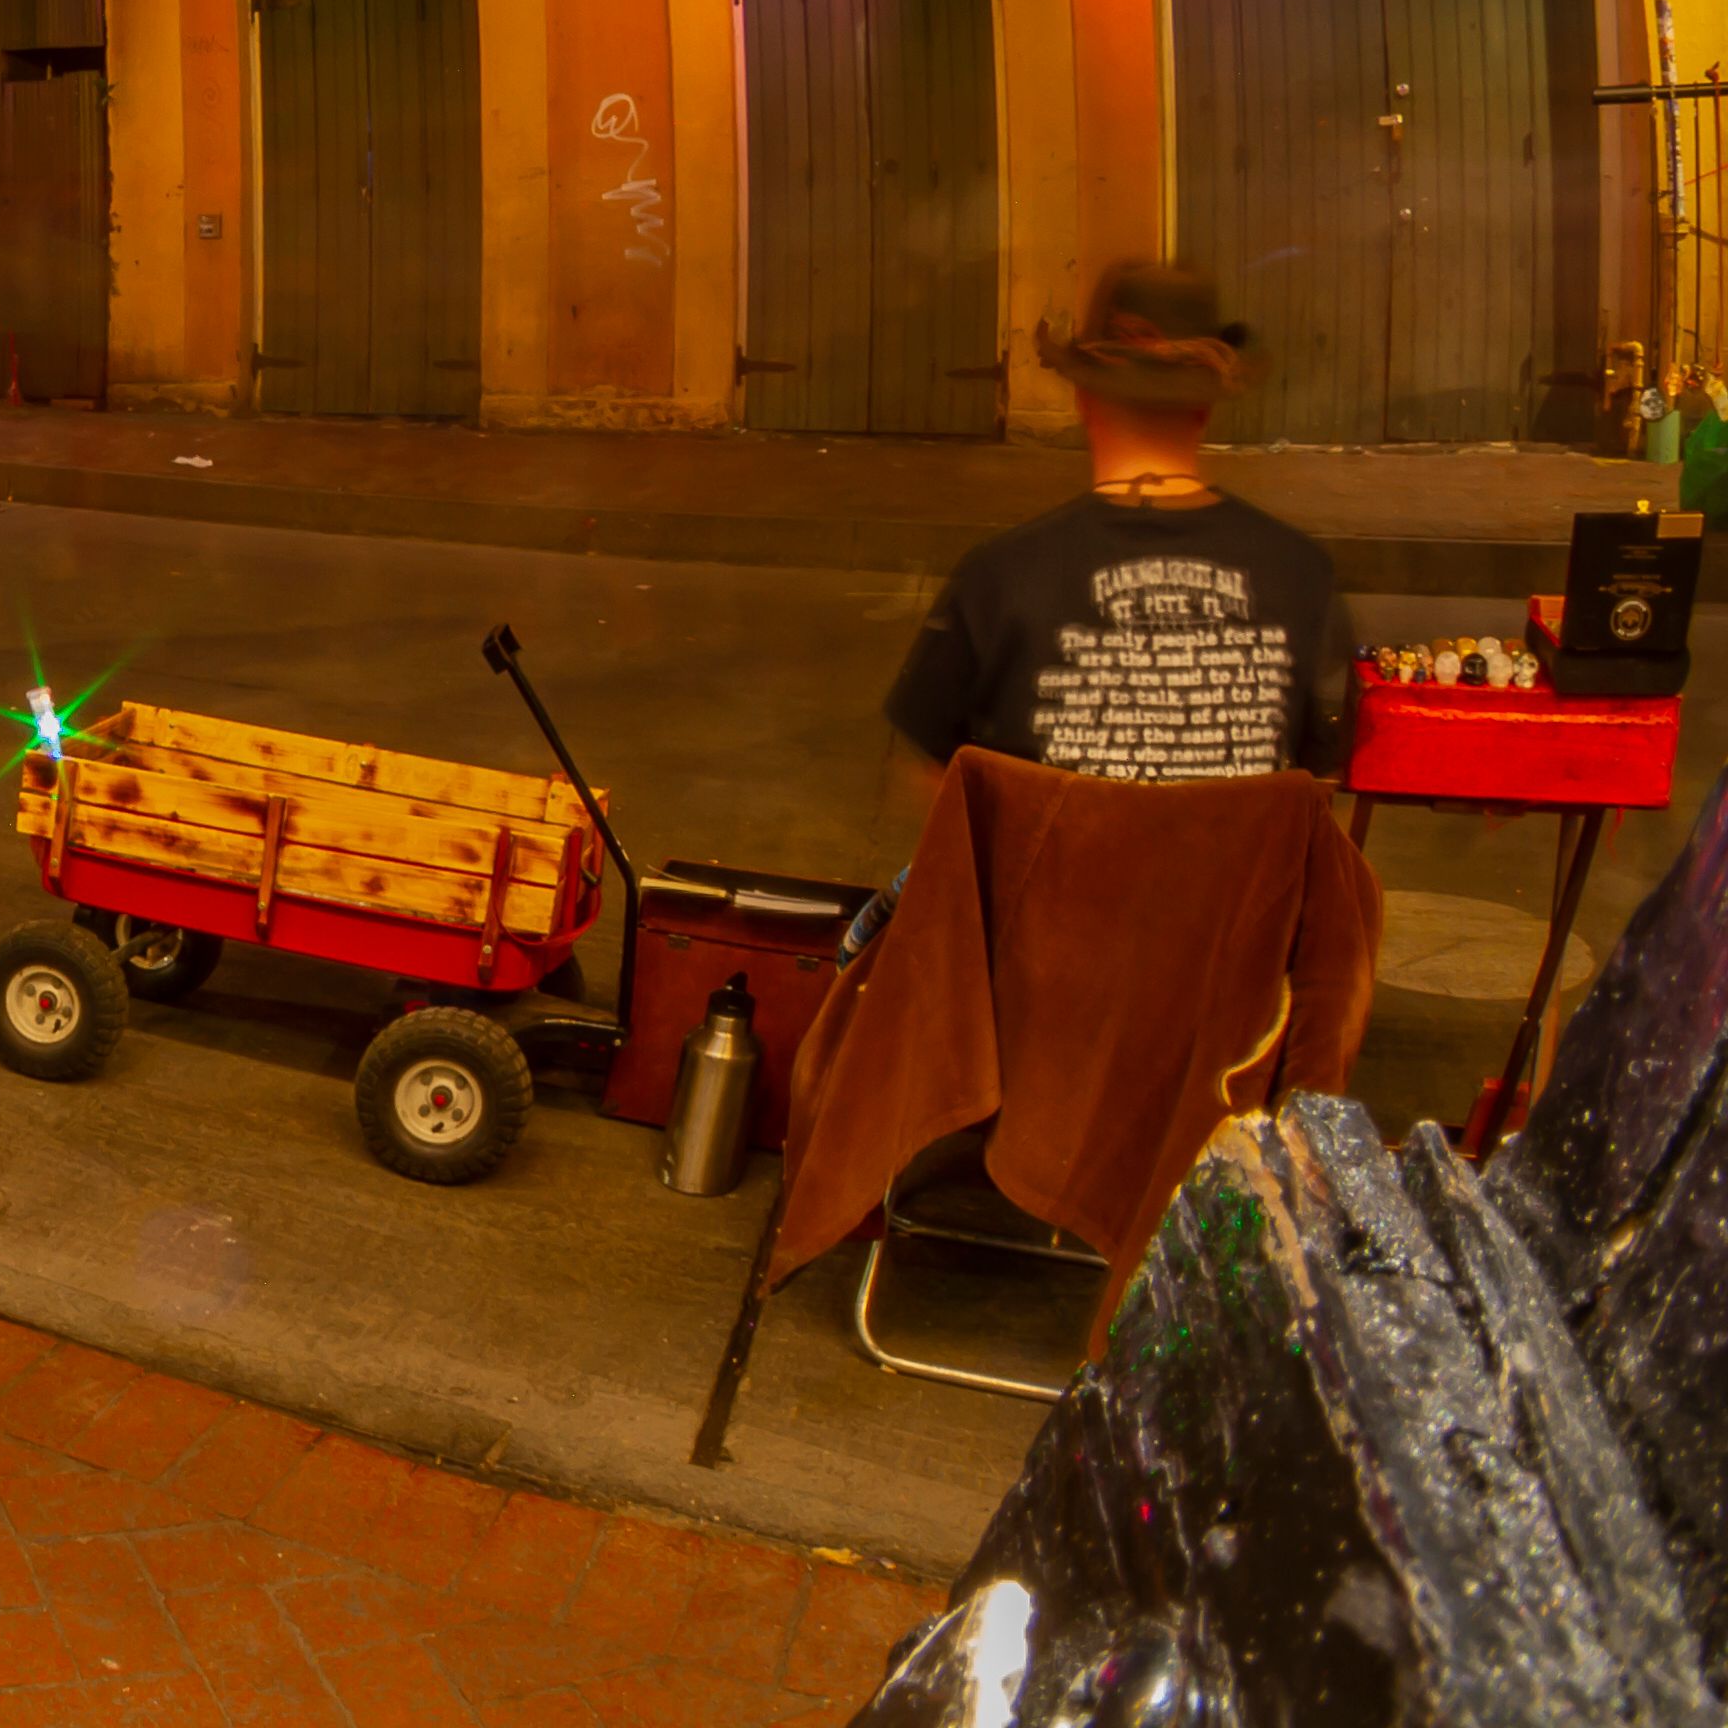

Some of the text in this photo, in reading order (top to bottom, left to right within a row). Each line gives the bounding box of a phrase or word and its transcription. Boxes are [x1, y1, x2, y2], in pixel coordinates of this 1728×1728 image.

[1061, 628, 1286, 651] The only people for me
[1079, 652, 1112, 666] are
[1119, 650, 1152, 666] the
[1157, 650, 1193, 666] mad
[1038, 673, 1081, 686] ones
[1087, 671, 1123, 686] who
[1128, 672, 1161, 686] are
[1166, 669, 1202, 686] mad
[1209, 669, 1231, 684] to
[1064, 690, 1102, 705] mad
[1108, 690, 1129, 705] to
[1189, 688, 1224, 705] mad
[1231, 687, 1252, 702] to
[1102, 708, 1185, 725] desirous
[1191, 708, 1212, 724] of
[1053, 728, 1109, 746] thing
[1114, 729, 1138, 744] at
[1143, 728, 1175, 744] the
[1182, 729, 1225, 744] same
[1047, 744, 1081, 760] the
[1087, 746, 1129, 760] ones
[1134, 745, 1168, 761] who
[1172, 747, 1226, 761] never
[1105, 764, 1139, 779] say
[1145, 765, 1157, 777] a
